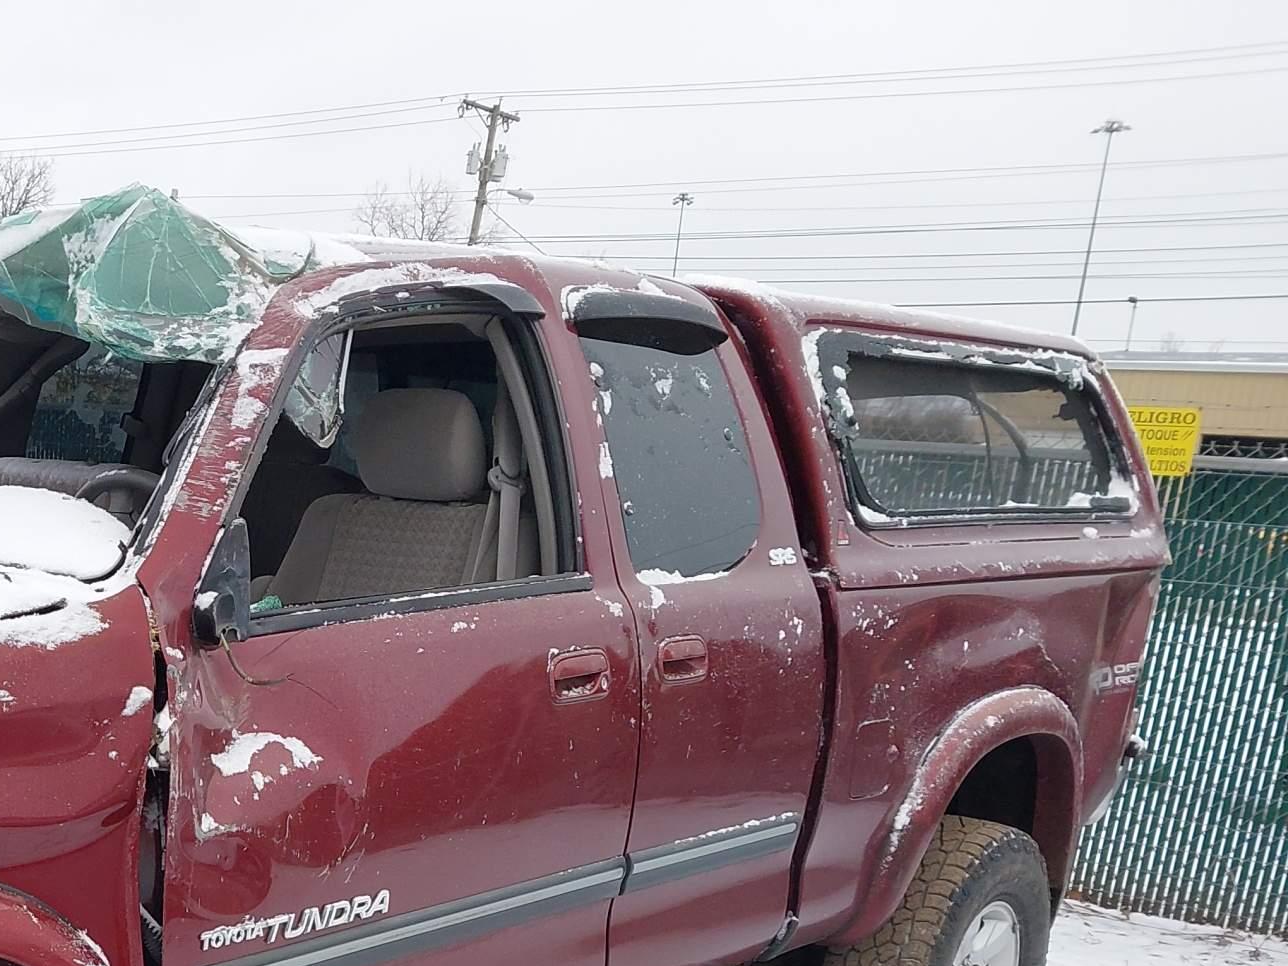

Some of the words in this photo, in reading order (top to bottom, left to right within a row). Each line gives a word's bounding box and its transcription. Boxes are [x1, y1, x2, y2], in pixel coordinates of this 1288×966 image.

[1140, 429, 1180, 441] TOQUE
[200, 921, 264, 951] TOYOTA
[263, 889, 390, 945] TUNDRA
